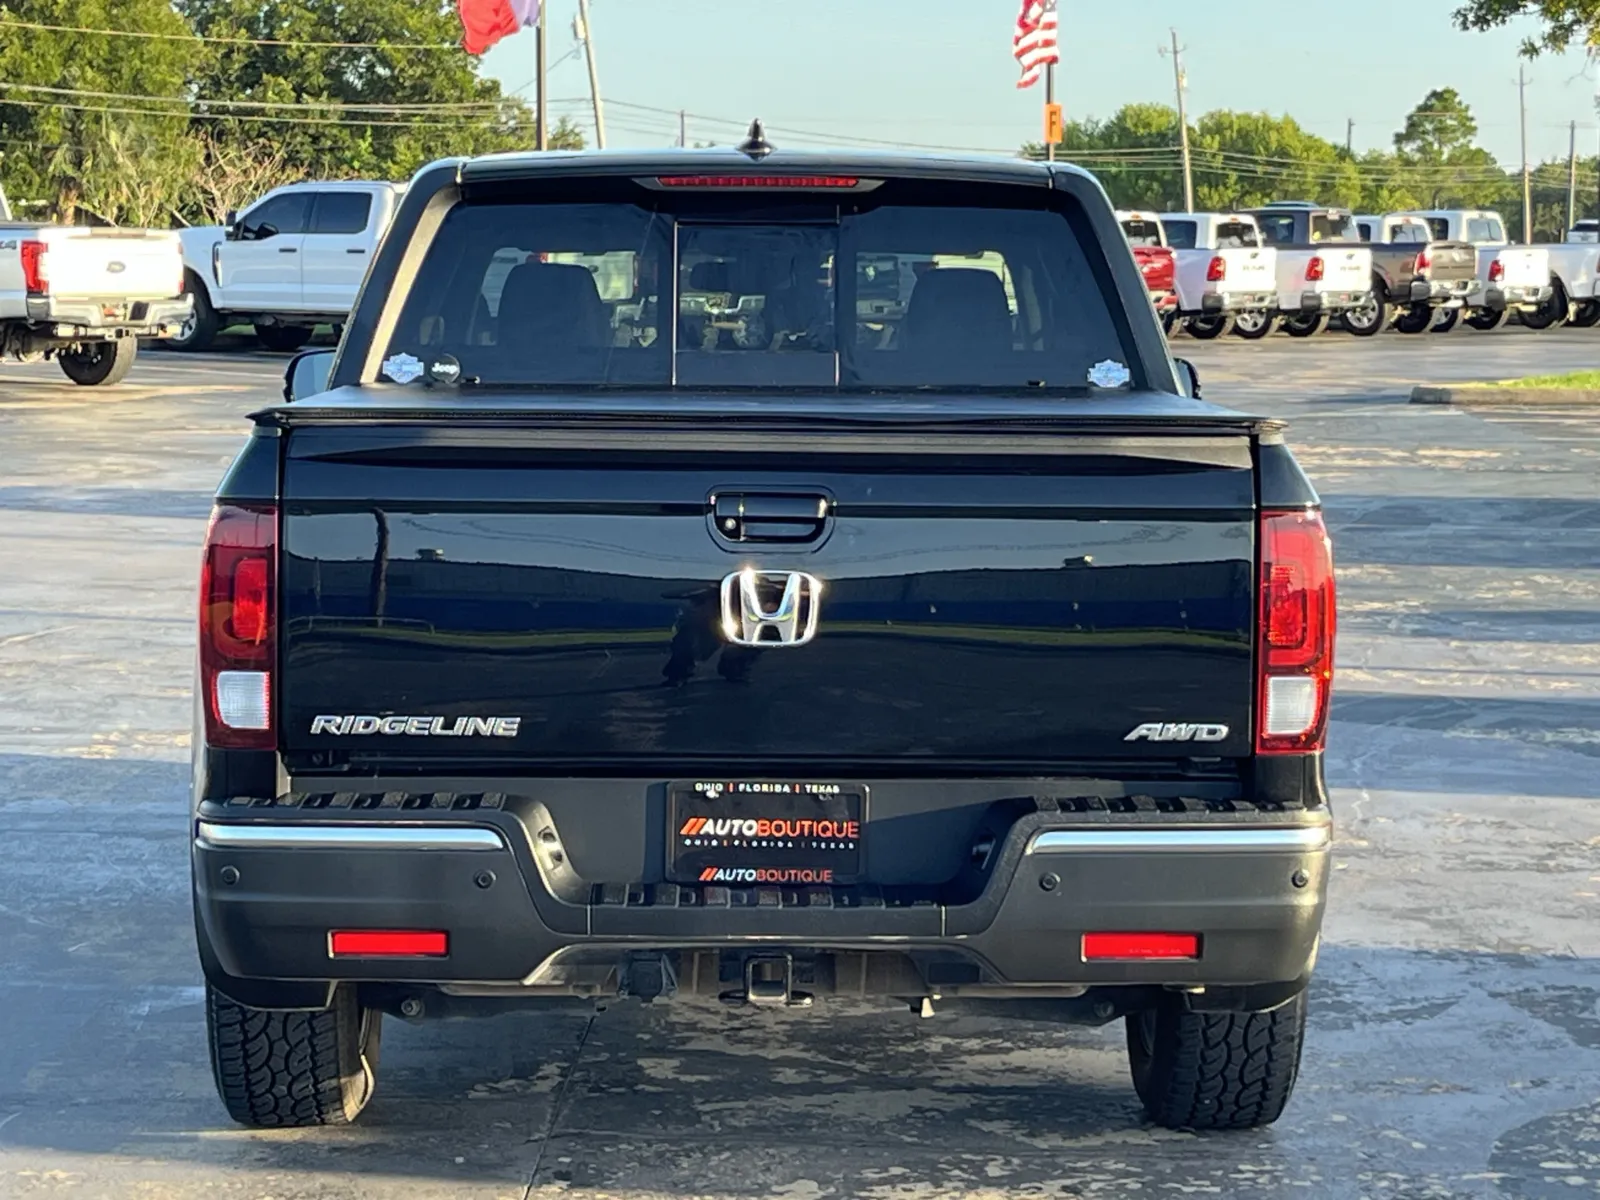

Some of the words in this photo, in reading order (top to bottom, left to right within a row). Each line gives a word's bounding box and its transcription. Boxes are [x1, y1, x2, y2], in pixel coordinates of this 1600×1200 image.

[310, 715, 522, 736] RIDGELINE
[1123, 722, 1229, 741] AWD
[695, 782, 724, 792] OHIO
[738, 783, 791, 793] FLORIDA
[804, 784, 840, 794] TEXAS
[699, 818, 860, 838] AUTOBOUTIQUE
[713, 868, 833, 882] AUTOBOUTIQUE
